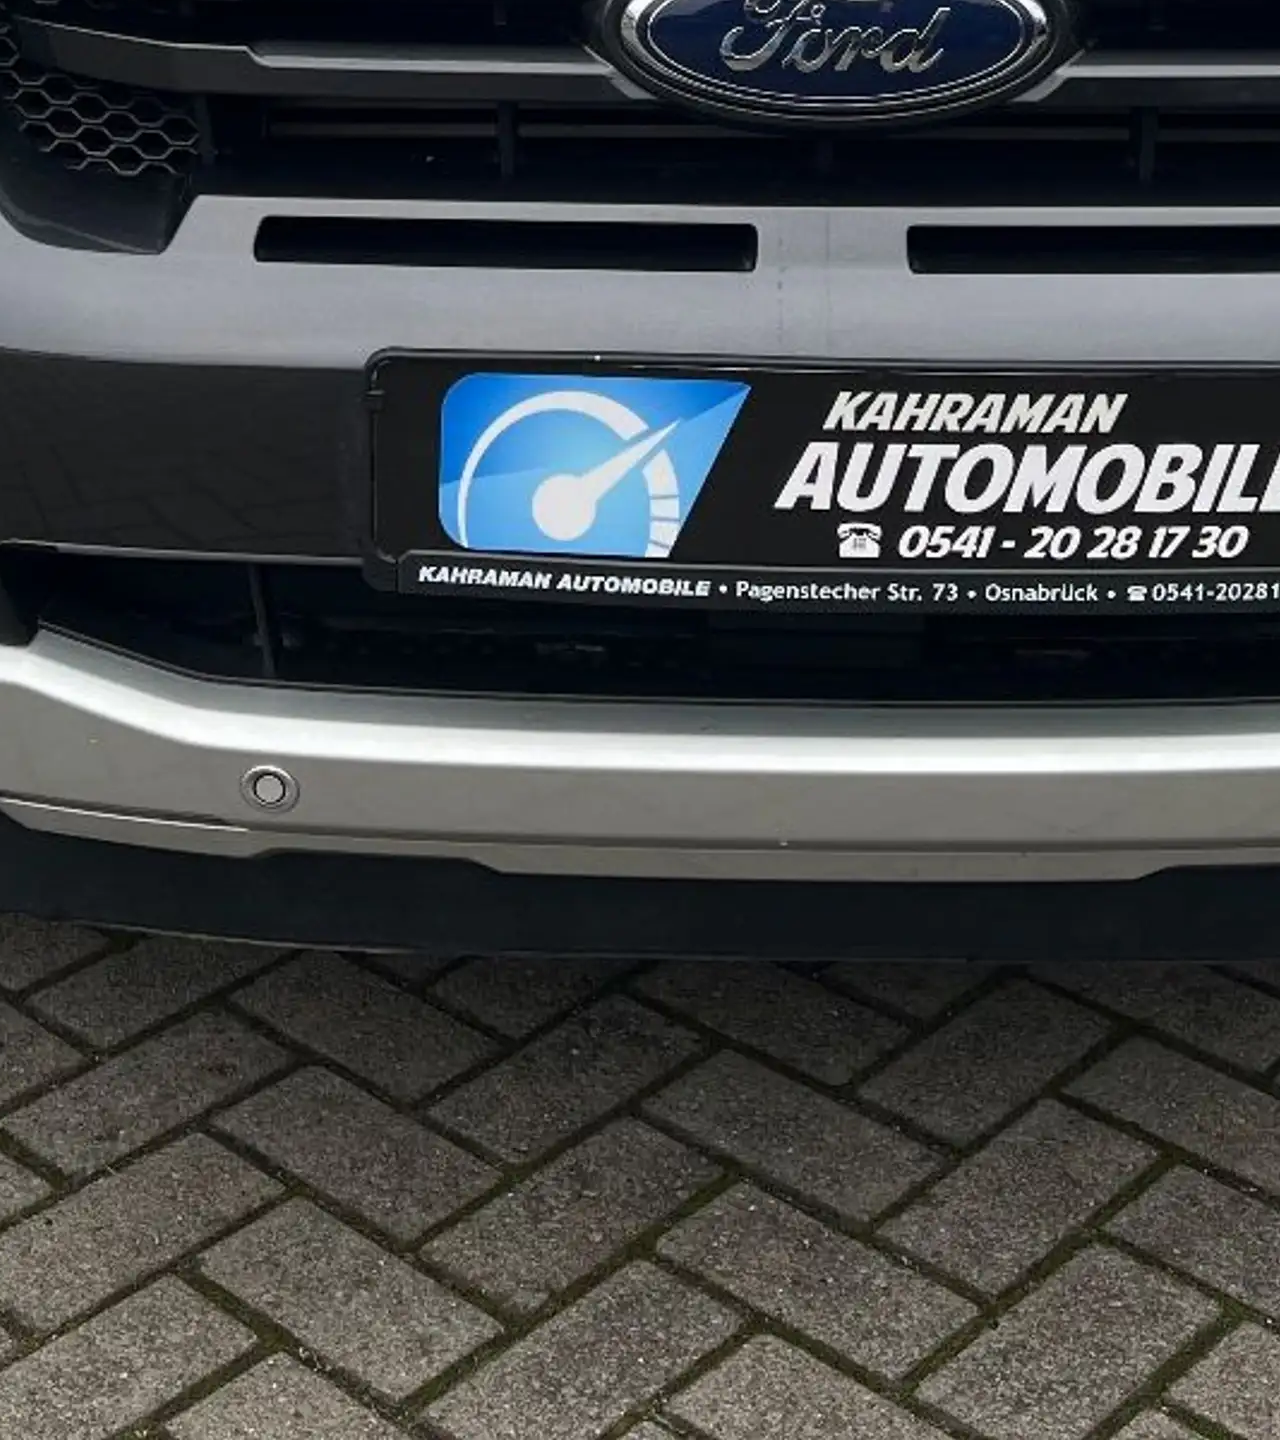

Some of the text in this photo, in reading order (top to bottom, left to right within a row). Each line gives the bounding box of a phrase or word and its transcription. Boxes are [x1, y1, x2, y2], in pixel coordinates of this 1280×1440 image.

[822, 391, 1128, 433] KAHRAMAN
[898, 525, 994, 558] 0541
[1022, 525, 1082, 558] 20
[1086, 525, 1139, 559] 28
[1148, 525, 1190, 558] 17
[1192, 525, 1249, 559] 30
[418, 565, 552, 590] KAHRAMAN
[556, 573, 711, 597] AUTOMOBILE
[736, 580, 878, 603] Pagenstecher
[887, 582, 922, 602] Str.
[933, 583, 959, 601] 73
[985, 582, 1098, 602] Osnabrück
